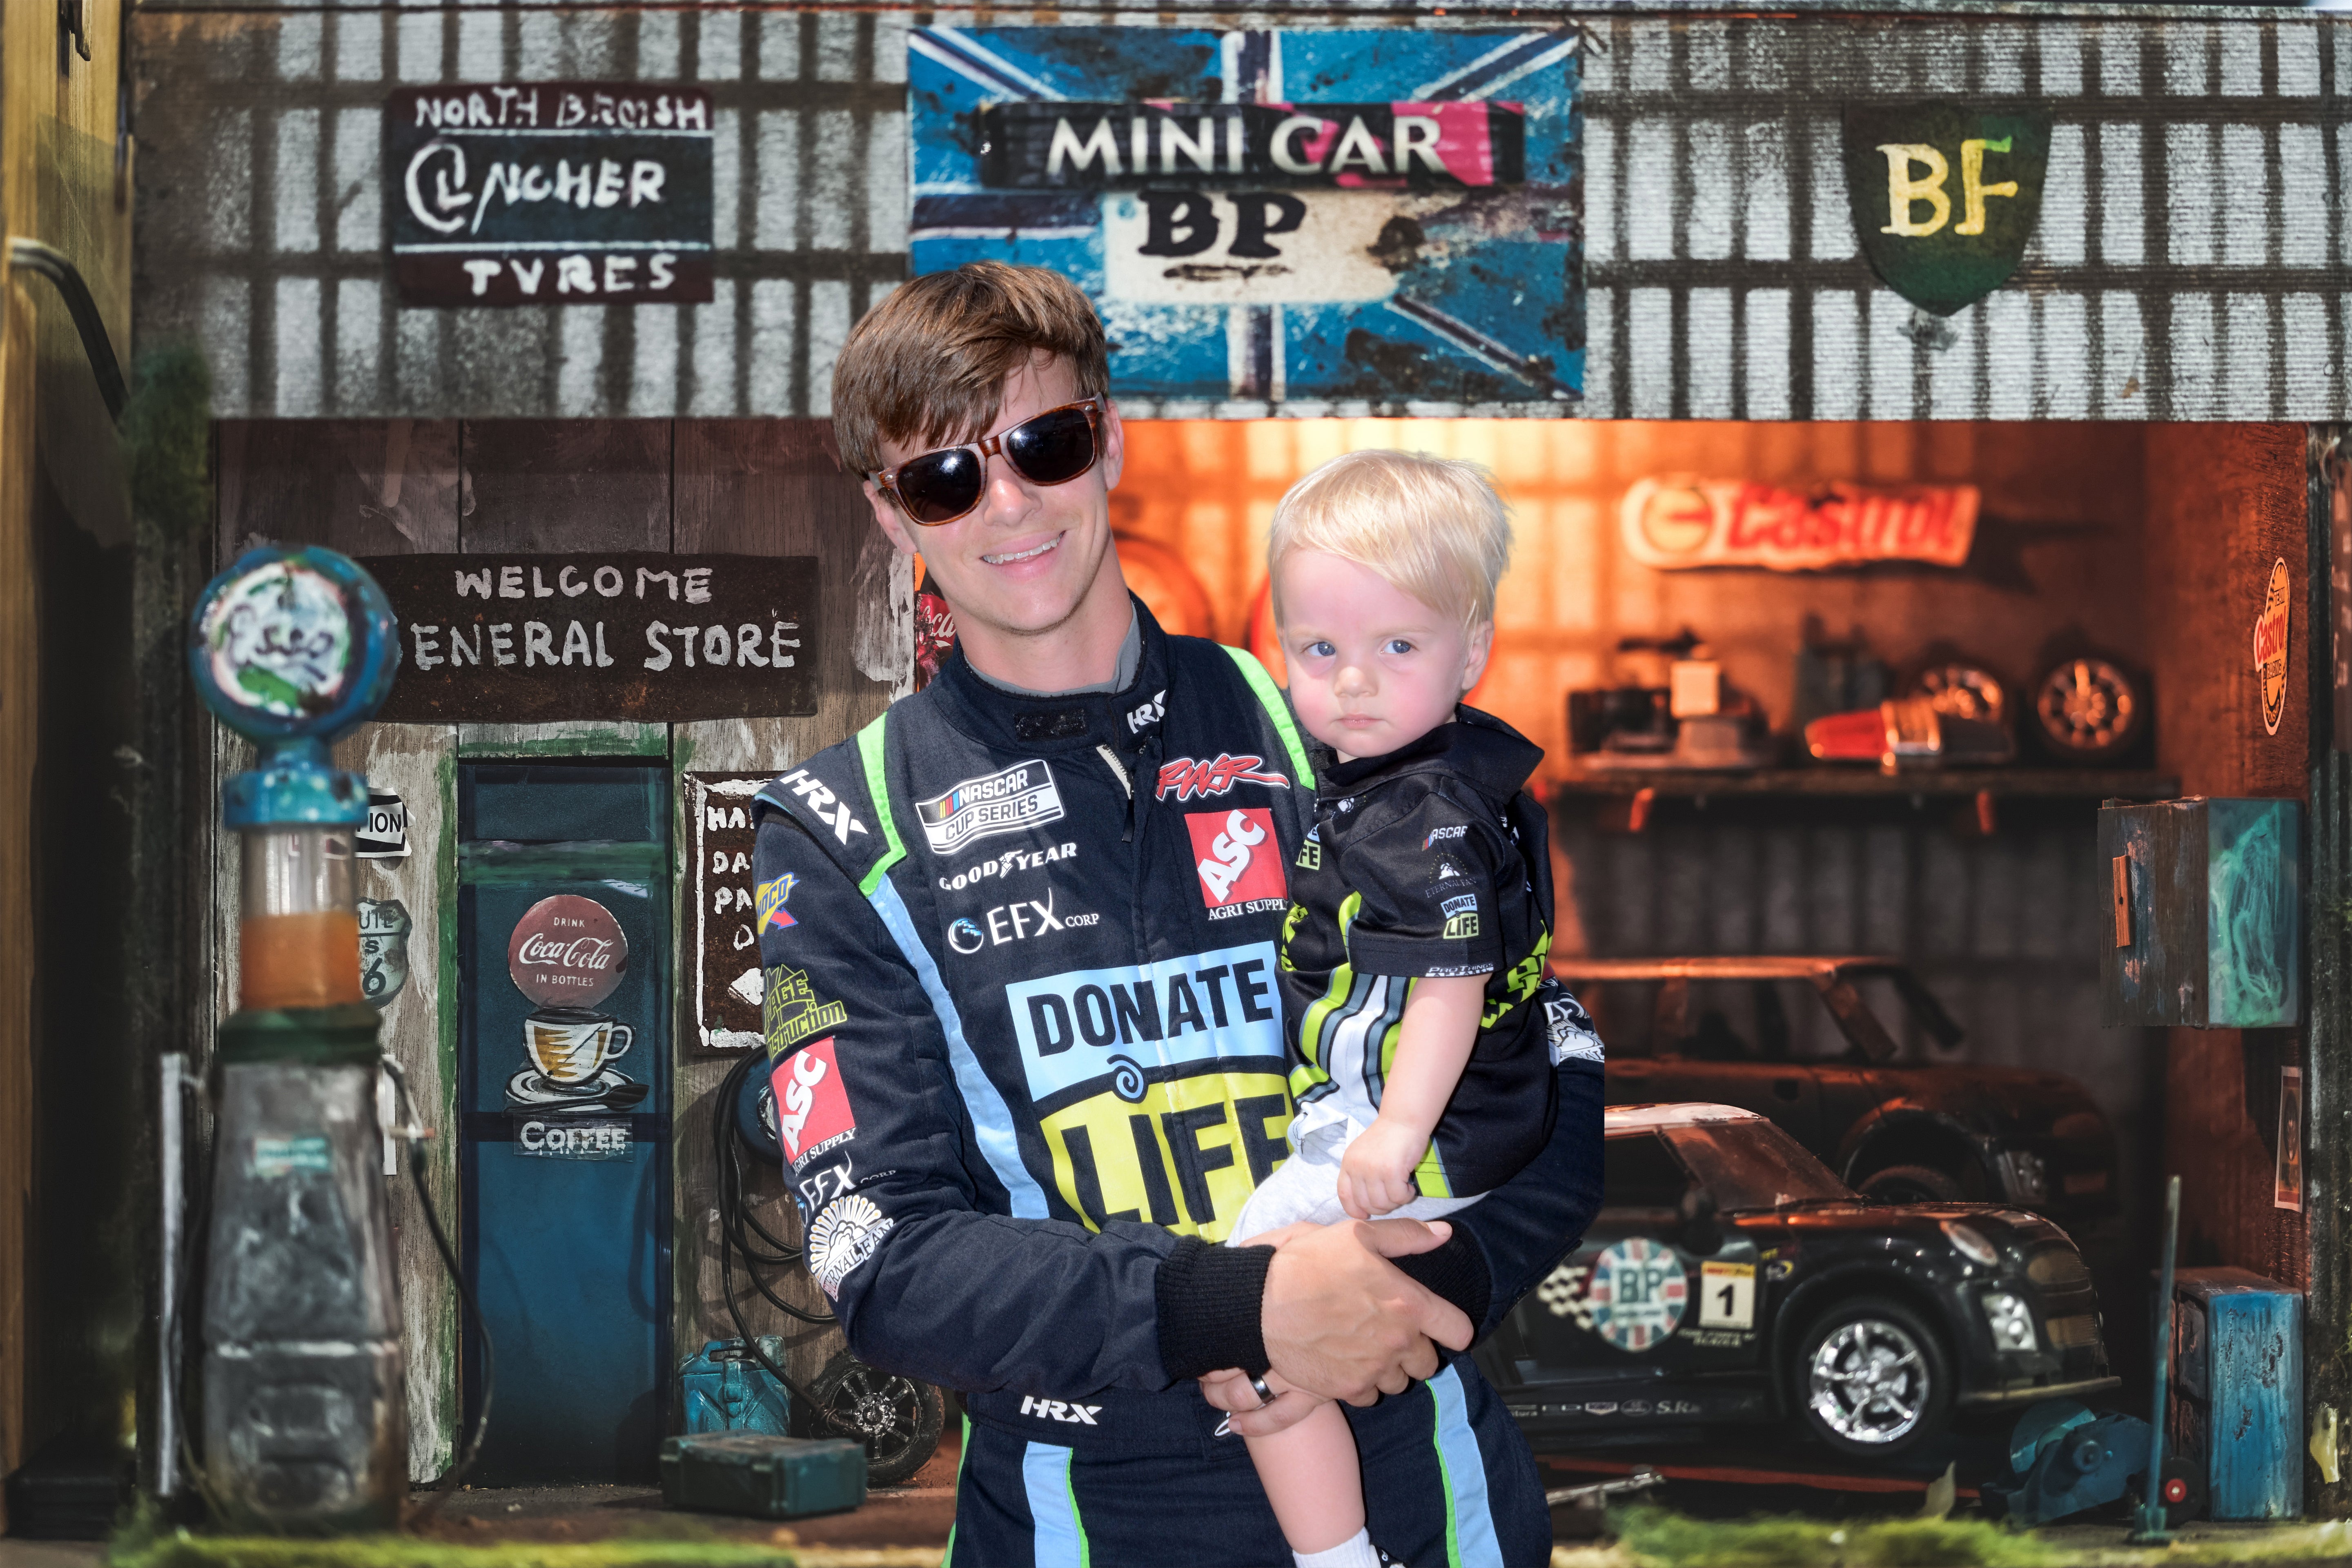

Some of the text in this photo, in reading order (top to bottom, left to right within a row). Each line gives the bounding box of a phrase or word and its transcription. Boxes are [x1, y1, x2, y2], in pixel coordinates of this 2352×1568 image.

[415, 86, 538, 127] NORTH
[1046, 115, 1446, 176] MINI CAR
[1138, 189, 1305, 258] BP
[455, 565, 713, 604] WELCOME
[394, 617, 614, 670] ENERAL
[644, 620, 801, 672] STORE
[2256, 606, 2286, 664] Castrol
[1127, 689, 1166, 734] HRX
[780, 769, 869, 845] HRX
[959, 769, 1028, 807] NASCAR
[357, 813, 402, 833] ION
[946, 794, 1038, 840] CUP SERIES
[1197, 809, 1265, 903] ASC
[554, 917, 585, 928] DRINK
[987, 887, 1099, 945] EFX CORP
[1208, 905, 1243, 921] AGRI
[1443, 896, 1475, 913] DONATE
[1447, 916, 1477, 936] LIFE
[519, 933, 614, 969] Coca-Cola
[537, 974, 594, 987] IN BOTTLES
[1027, 958, 1274, 1058] DONATE
[782, 1050, 828, 1156] ASC
[811, 1128, 856, 1159] SUPPLY
[1619, 1269, 1662, 1303] BP
[1718, 1284, 1734, 1316] 1
[1020, 1395, 1102, 1425] HRX
